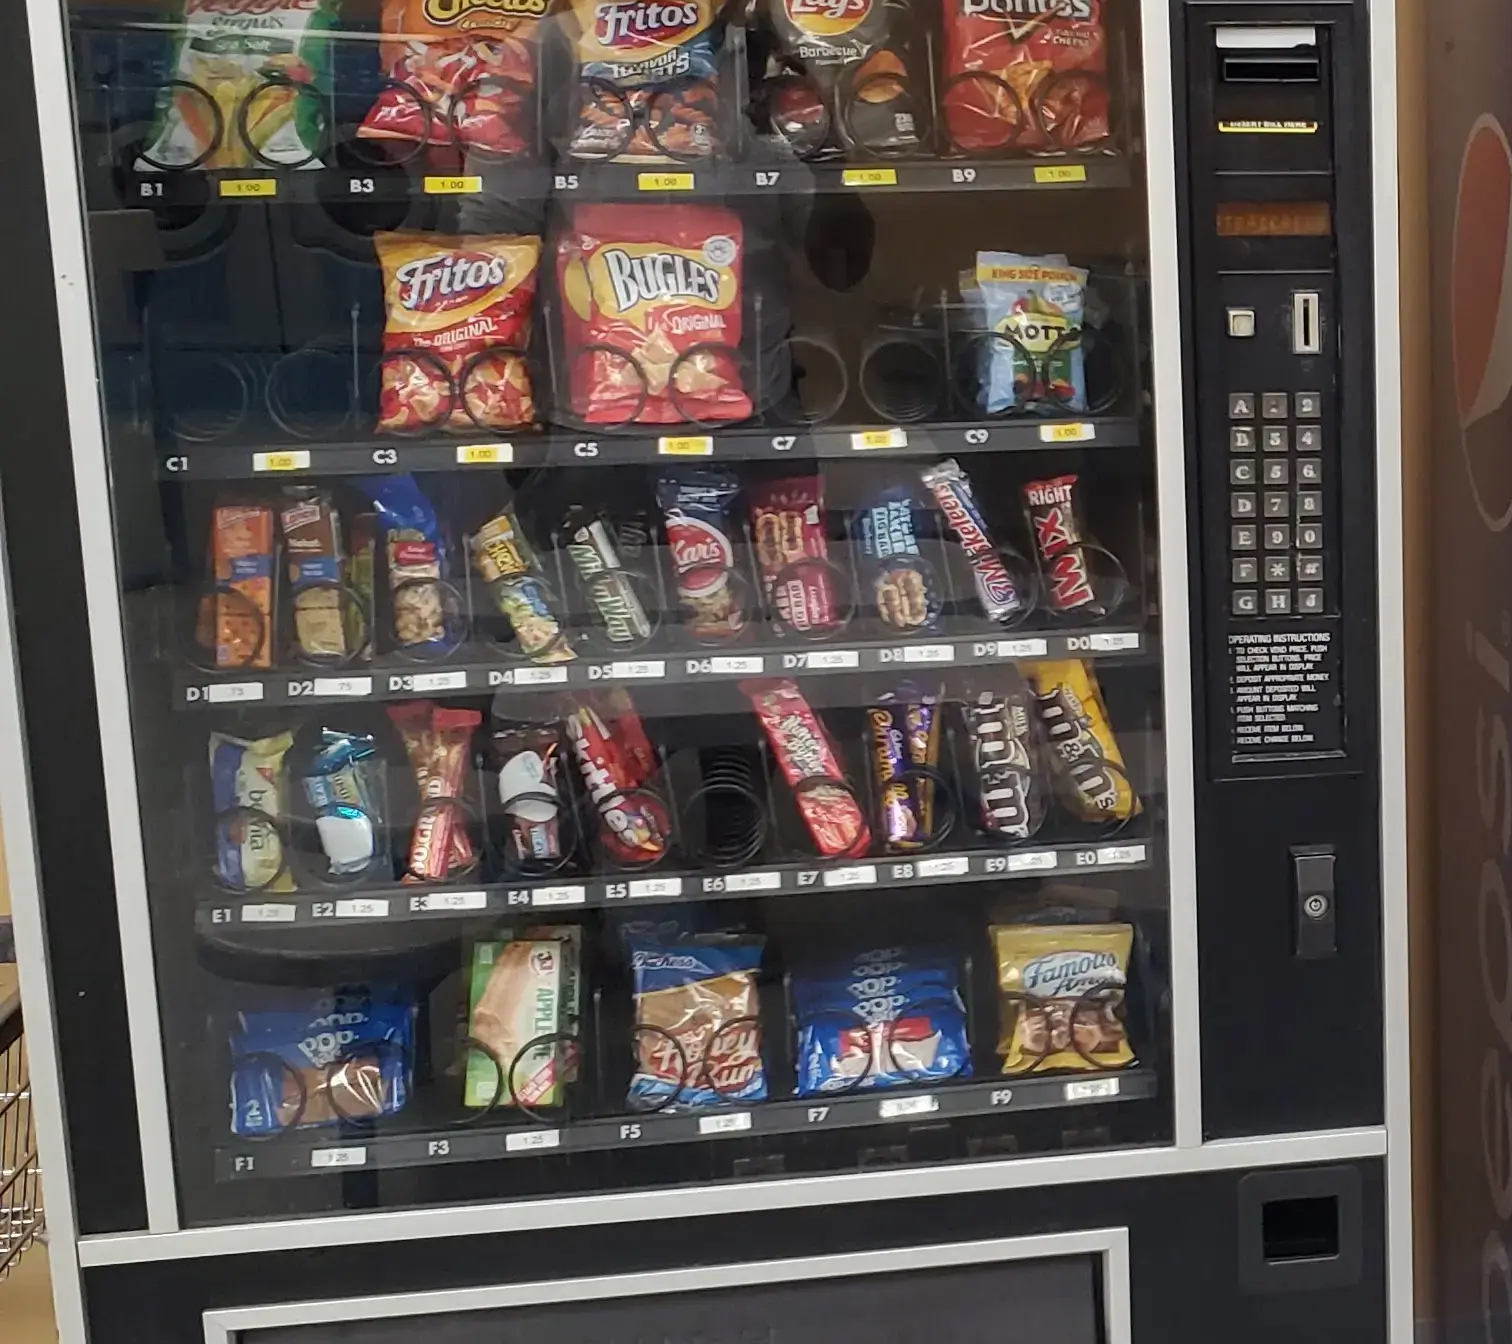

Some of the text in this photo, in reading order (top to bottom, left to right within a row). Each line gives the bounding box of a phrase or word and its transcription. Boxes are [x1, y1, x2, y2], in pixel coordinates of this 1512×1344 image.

[594, 1, 700, 46] Fritos
[554, 175, 579, 189] B5
[755, 171, 780, 186] B7
[951, 167, 976, 183] B9
[140, 182, 164, 197] B1
[349, 178, 375, 193] B3
[397, 252, 505, 309] Fritos
[604, 248, 721, 313] BUGLES
[433, 316, 498, 347] ORIGINAL
[1233, 399, 1249, 414] A
[771, 436, 797, 451] C7
[964, 429, 990, 444] C9
[1301, 431, 1313, 445] 4
[371, 449, 398, 465] C3
[573, 443, 599, 457] C5
[166, 456, 189, 472] C1
[1302, 464, 1316, 478] 6
[1236, 464, 1250, 480] C
[1028, 485, 1073, 506] RIGHT
[1237, 498, 1252, 513] D
[1270, 497, 1282, 512] 7
[1303, 497, 1315, 511] 8
[1238, 531, 1252, 545] E
[1271, 530, 1283, 545] 9
[1034, 507, 1095, 611] TWIX
[1238, 596, 1253, 610] G
[1271, 595, 1286, 609] H
[1305, 593, 1317, 608] J
[1228, 632, 1331, 644] OPERATING INSTRUCTIONS
[880, 648, 904, 663] D8
[973, 642, 997, 657] D9
[686, 660, 711, 674] D6
[783, 654, 807, 669] D7
[489, 670, 514, 685] D4
[588, 665, 613, 679] D5
[288, 680, 314, 696] D2
[389, 675, 414, 691] D3
[186, 686, 209, 702] D1
[892, 863, 914, 878] E8
[985, 857, 1007, 872] E9
[702, 878, 725, 892] E6
[797, 871, 819, 885] E7
[508, 890, 530, 905] E4
[606, 884, 627, 899] E5
[312, 902, 334, 916] E2
[409, 896, 428, 911] E3
[212, 908, 232, 923] E1
[1023, 953, 1117, 989] Famous
[533, 987, 555, 1035] APPLE
[990, 1090, 1013, 1105] F9
[807, 1107, 830, 1123] F7
[620, 1124, 642, 1140] F5
[428, 1140, 450, 1156] F3
[235, 1156, 254, 1172] F1
